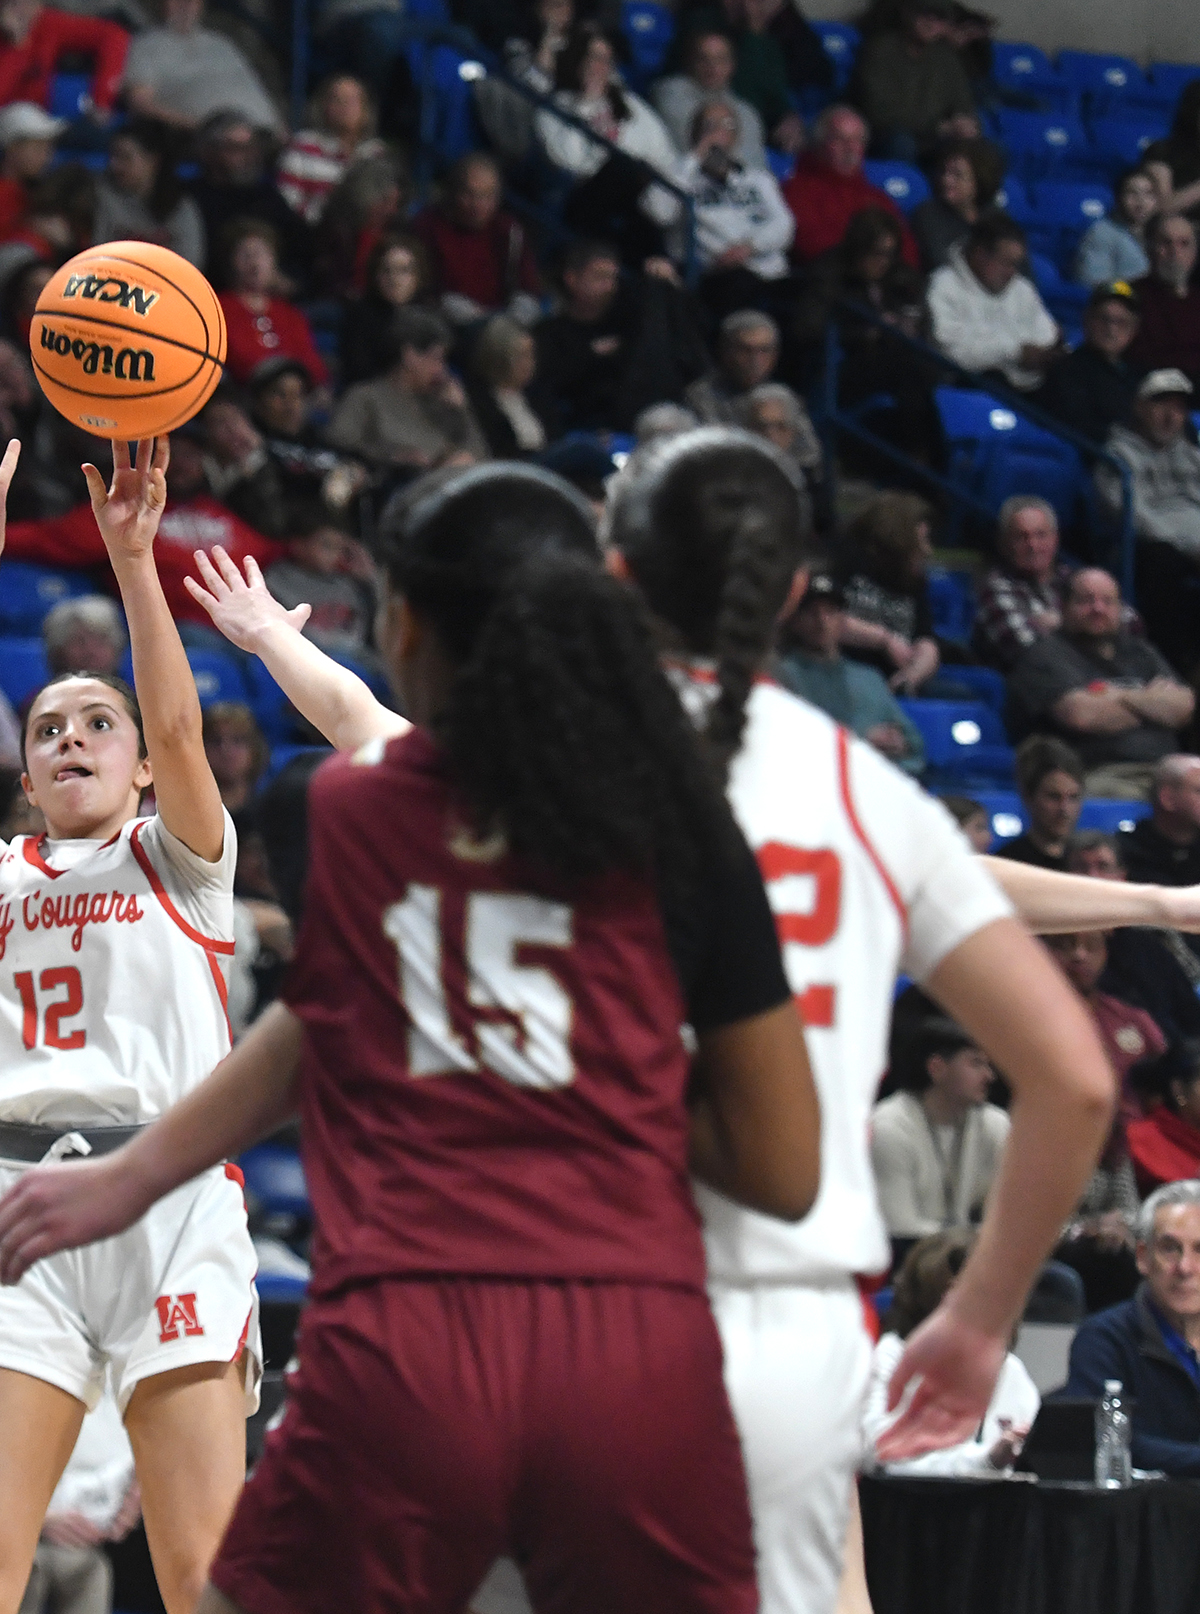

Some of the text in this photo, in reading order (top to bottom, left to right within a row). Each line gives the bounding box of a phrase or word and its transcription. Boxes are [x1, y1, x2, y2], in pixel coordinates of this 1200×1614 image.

[63, 273, 160, 318] NCAA
[40, 324, 155, 381] Wilson
[23, 889, 143, 951] Cougars
[13, 966, 86, 1051] 12
[383, 882, 575, 1090] 15
